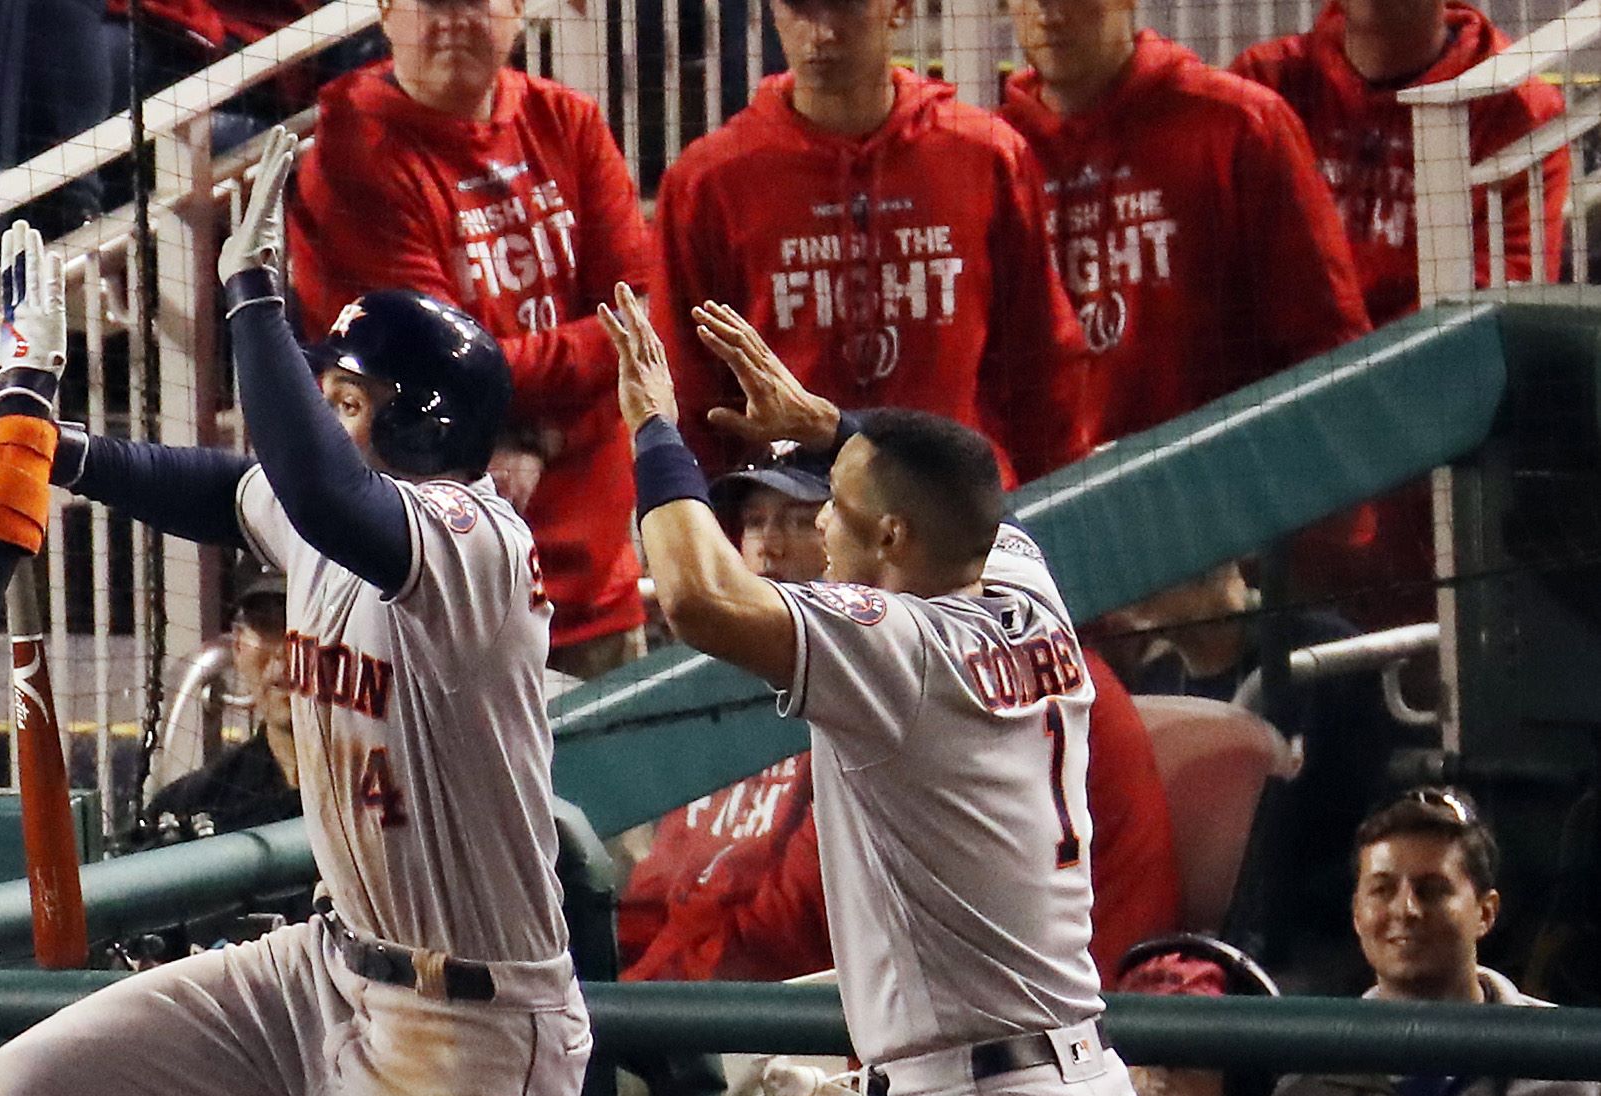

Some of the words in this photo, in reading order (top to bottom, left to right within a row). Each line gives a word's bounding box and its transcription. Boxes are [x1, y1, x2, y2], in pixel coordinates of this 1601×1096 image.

[1114, 190, 1163, 221] THE
[781, 235, 882, 266] FINI
[895, 225, 953, 256] THE
[772, 258, 963, 329] FIHT
[360, 747, 408, 828] 4
[1044, 697, 1080, 870] 1
